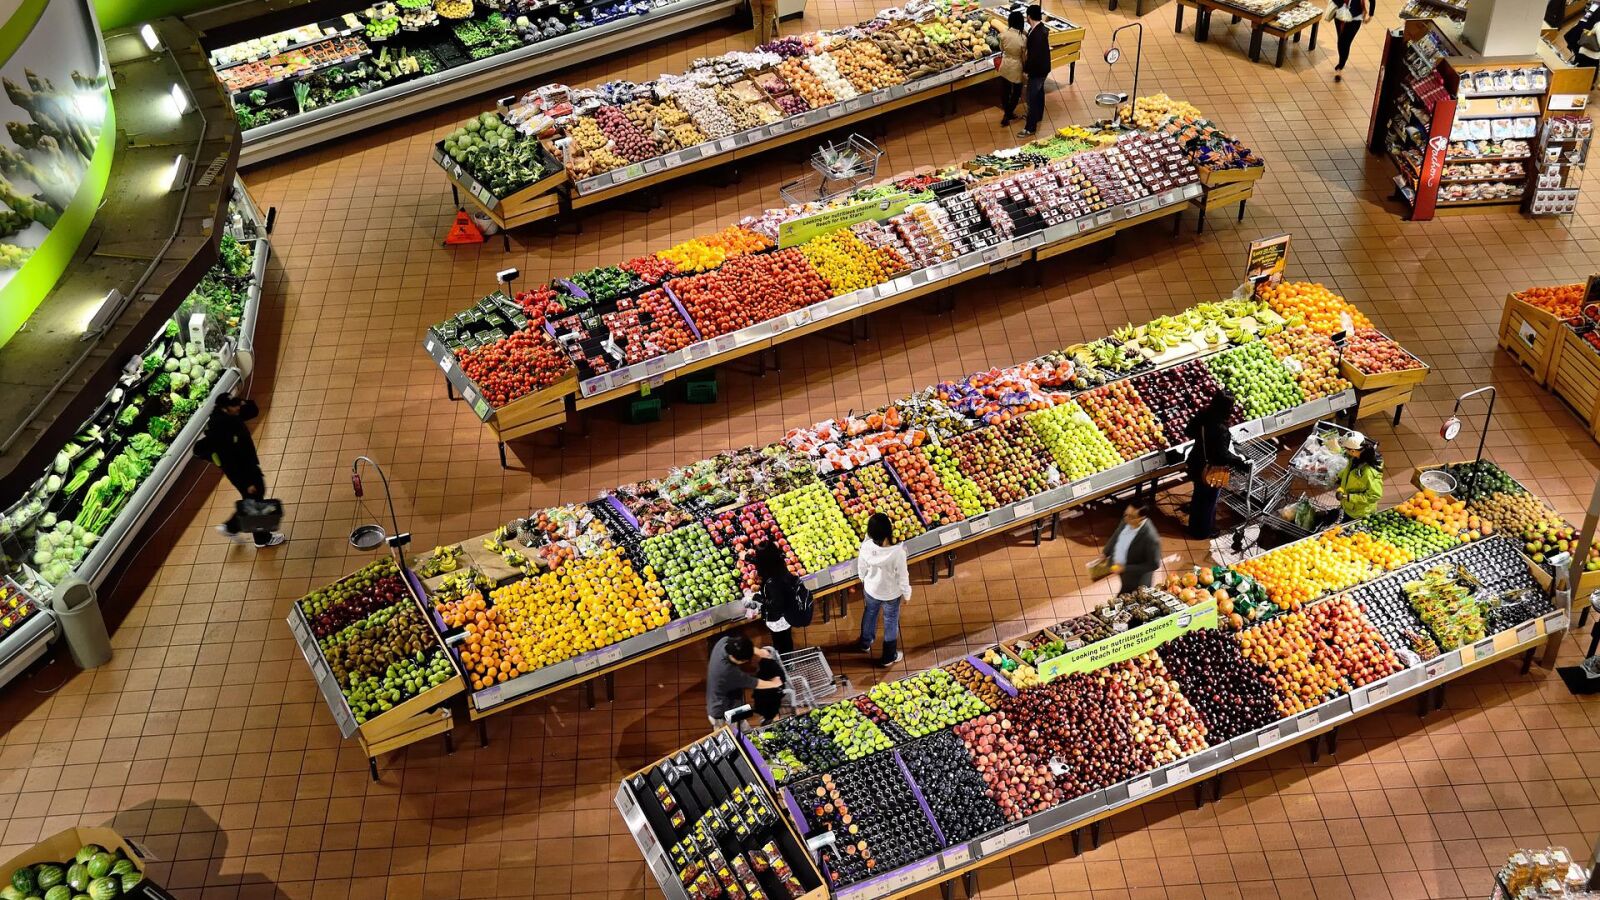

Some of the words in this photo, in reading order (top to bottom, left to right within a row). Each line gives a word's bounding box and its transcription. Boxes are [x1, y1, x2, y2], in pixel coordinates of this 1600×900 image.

[803, 218, 822, 226] Looking
[831, 210, 856, 219] nutritious
[857, 203, 877, 212] choices?
[1071, 649, 1098, 662] Looking
[1110, 631, 1144, 648] nutritious
[1145, 619, 1174, 635] choices?
[1090, 651, 1111, 662] Reach
[1123, 641, 1135, 650] the
[1136, 633, 1156, 645] Stars!
